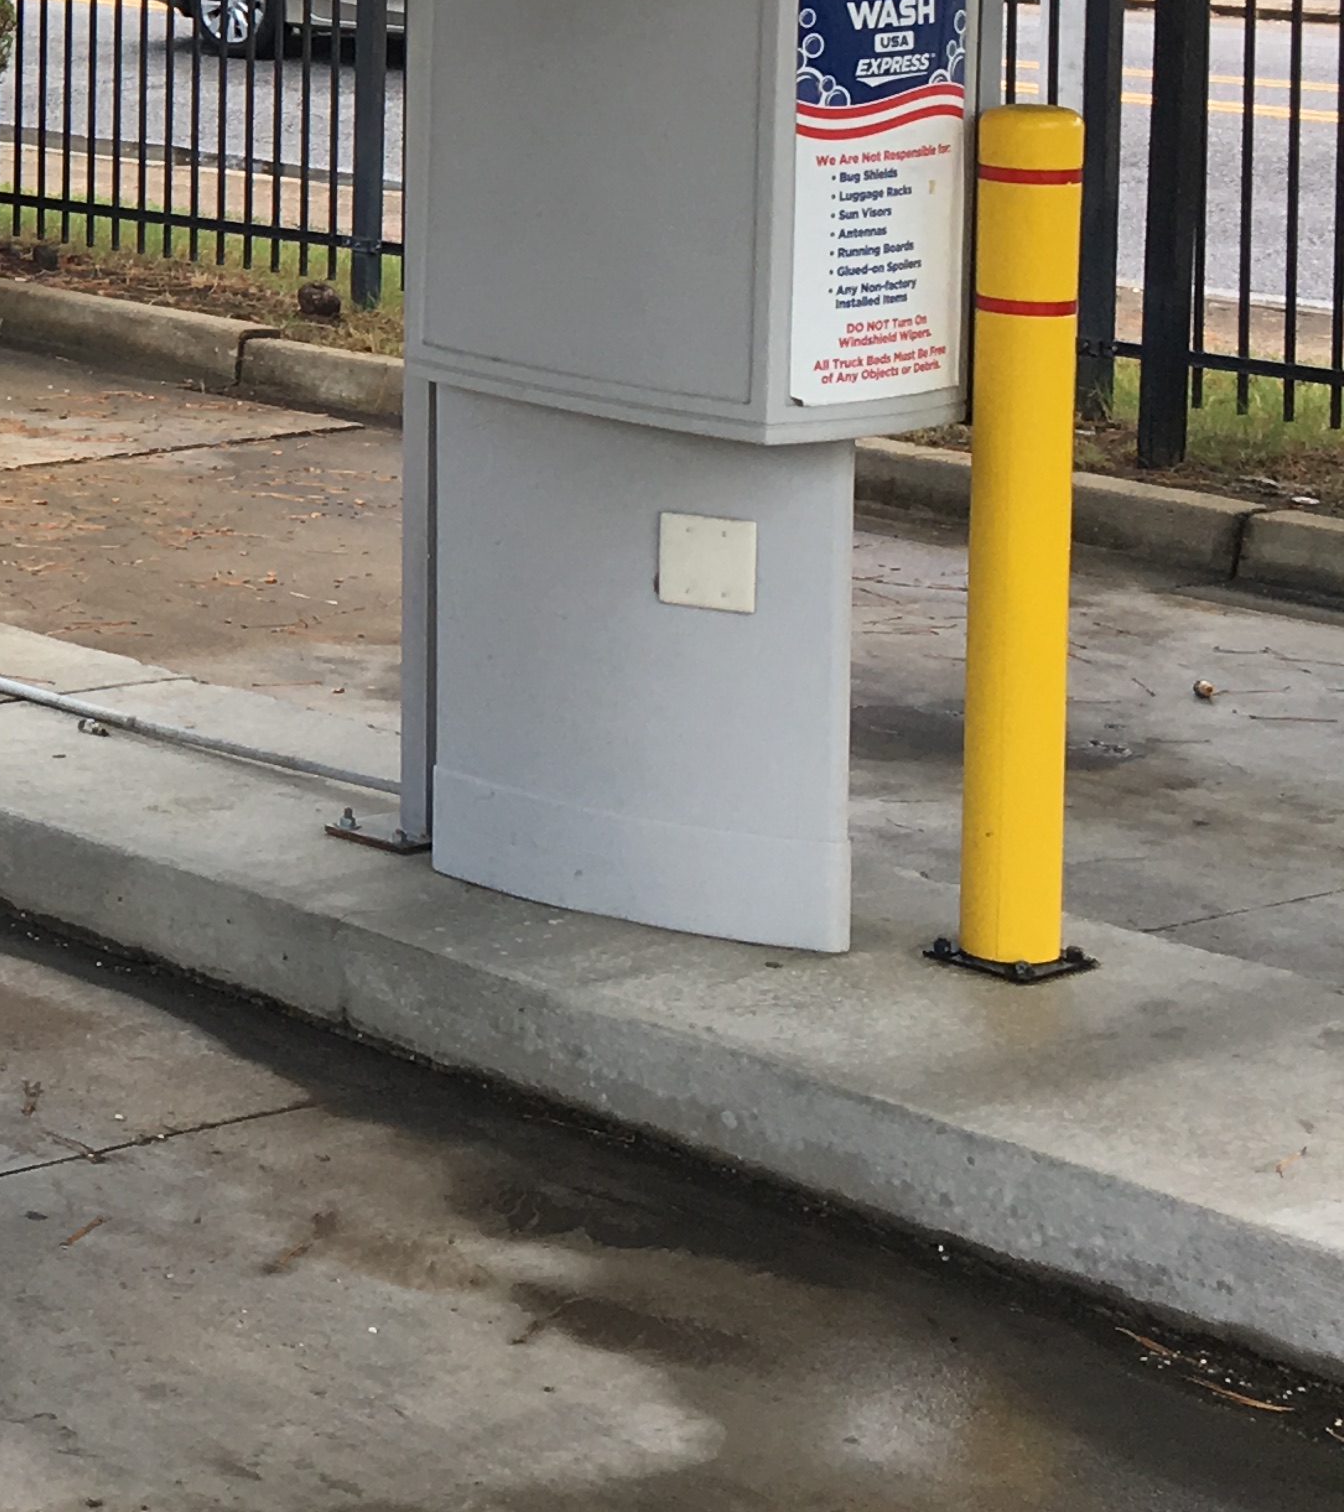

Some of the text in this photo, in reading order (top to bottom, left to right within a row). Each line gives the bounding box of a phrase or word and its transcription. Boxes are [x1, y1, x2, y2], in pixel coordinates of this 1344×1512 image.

[880, 35, 909, 49] USA
[855, 53, 930, 76] EXPRESS
[816, 143, 951, 166] We Are Not Responsible for:
[839, 167, 898, 183] Bug Shields
[839, 184, 913, 202] Luggage Racks
[838, 207, 892, 220] Sun Visors
[838, 226, 888, 239] Antennas
[837, 240, 914, 258] Running Boards
[837, 259, 922, 277] Glued-on Spoilers
[835, 278, 917, 296] Any Non-factory
[835, 293, 908, 309] Installed Items
[846, 314, 928, 334] DO NOT Turn On
[838, 328, 932, 348] Windshield Wipers.
[814, 345, 946, 371] All Truck Beds Must Be Free
[821, 359, 941, 384] of Any Objects or Debris.
